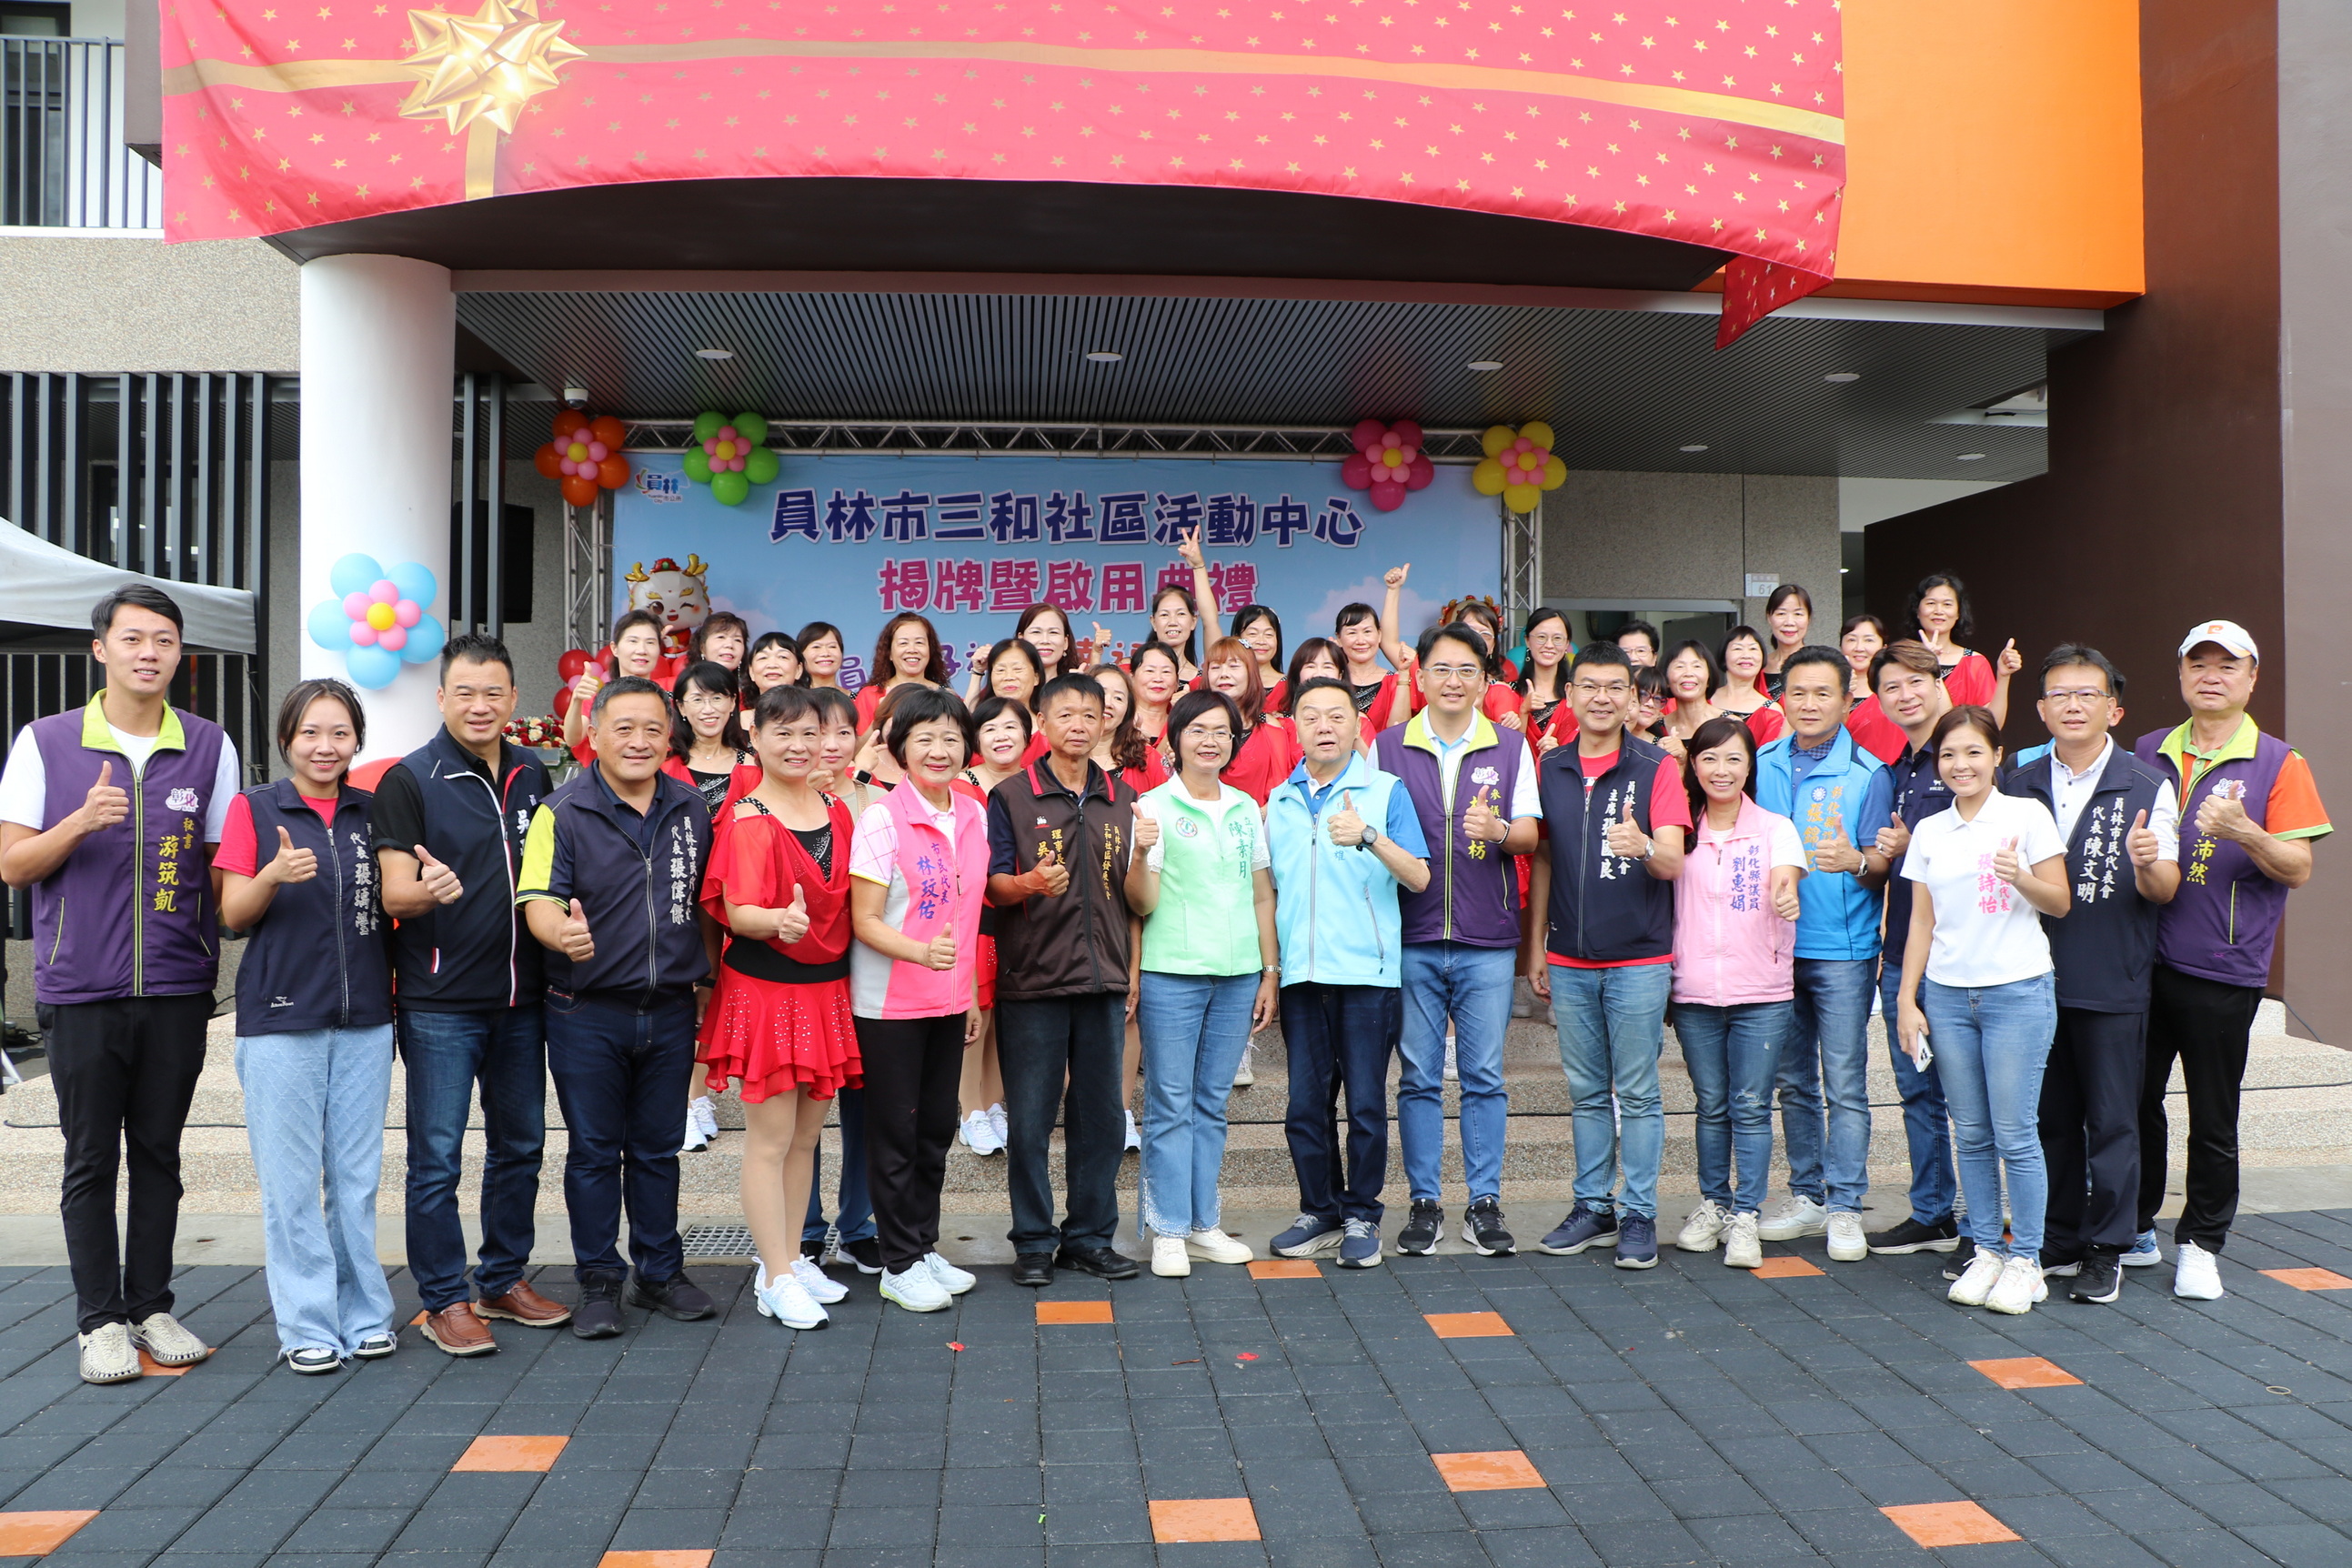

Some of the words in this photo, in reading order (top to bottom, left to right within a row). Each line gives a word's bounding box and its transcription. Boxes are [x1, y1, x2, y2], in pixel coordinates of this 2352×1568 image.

[769, 487, 1365, 548] 員林市三和社區活動中心
[183, 818, 196, 849] 秘書
[1229, 820, 1249, 879] 陳素月
[2076, 805, 2106, 904] 代表陳文明
[2099, 797, 2126, 900] 員林市民代表會
[154, 834, 180, 913] 游筑凱
[931, 842, 951, 906] 市民代表
[1730, 856, 1746, 912] 劉惠娟
[1747, 845, 1762, 910] 彰化縣議員
[1977, 852, 1998, 914] 張詩怡
